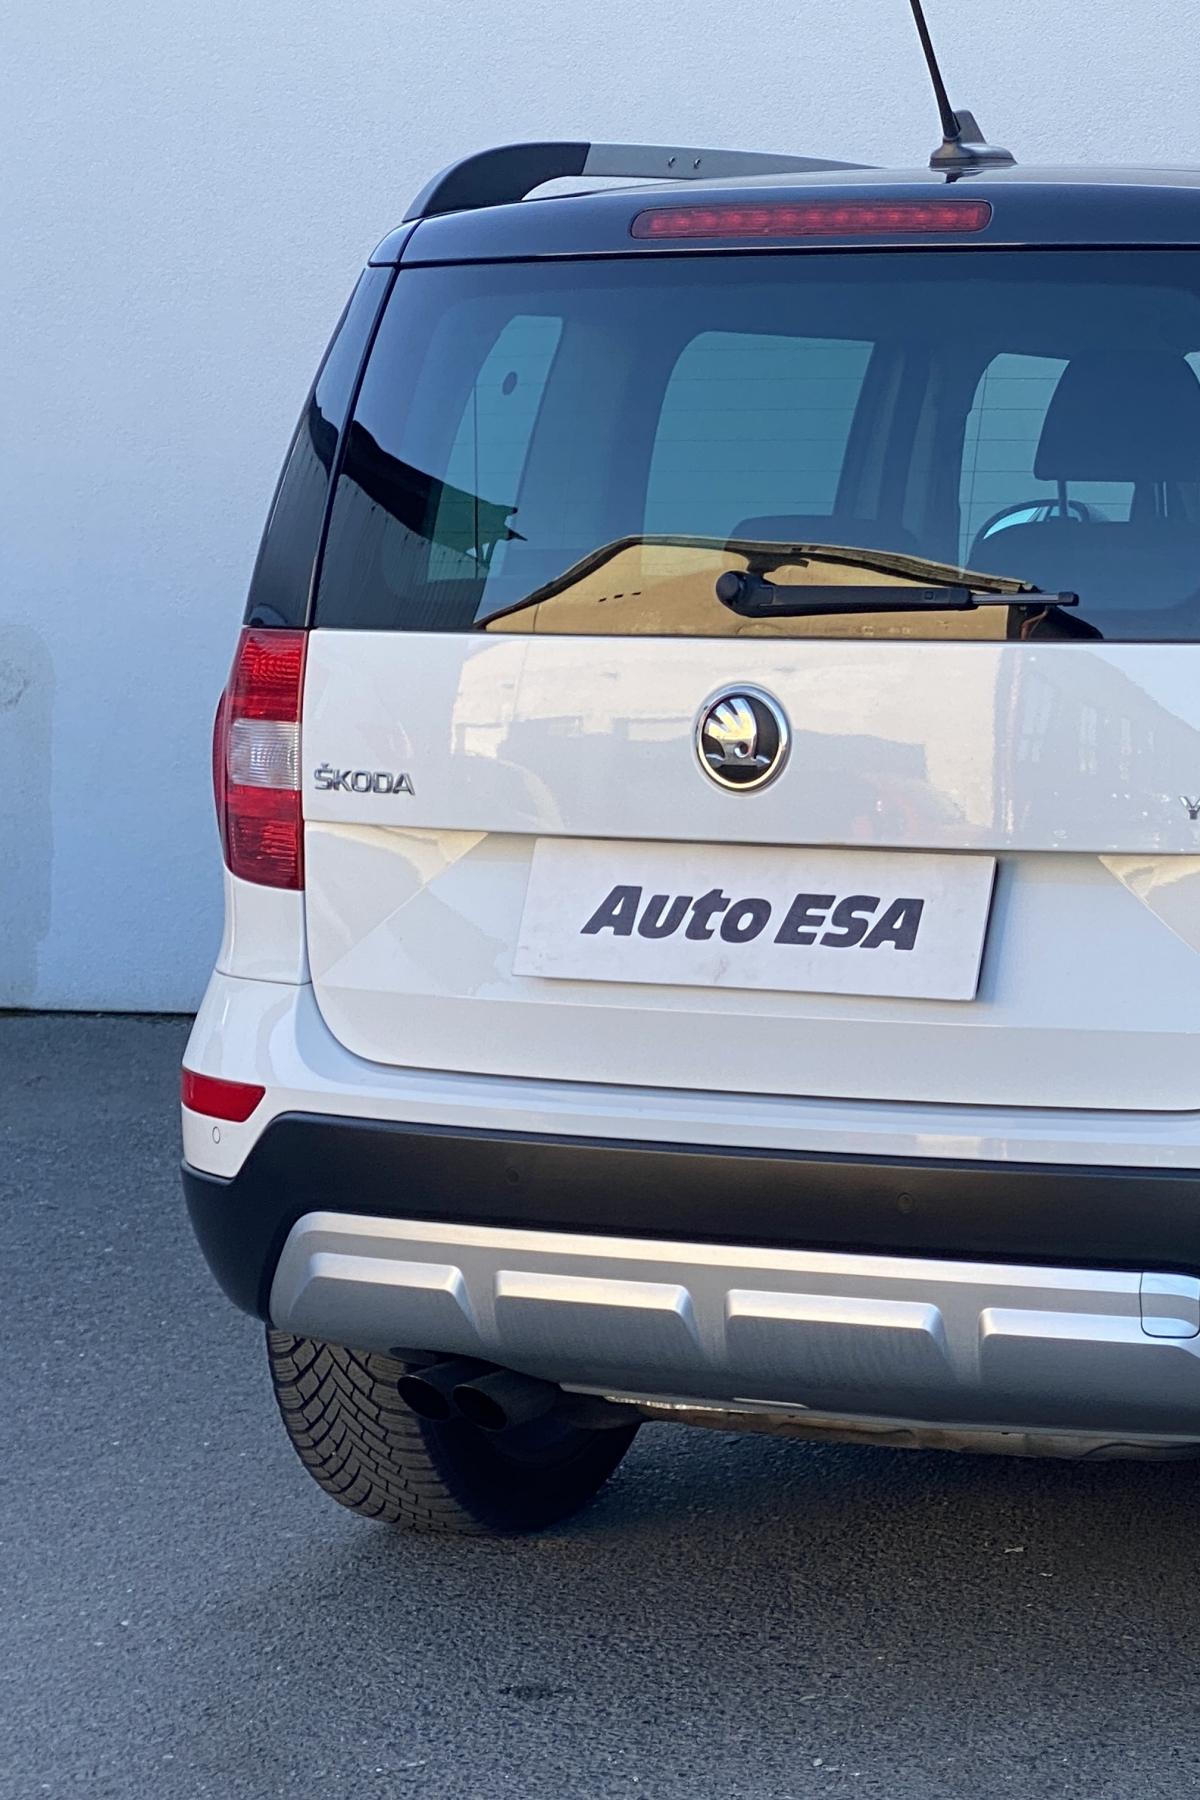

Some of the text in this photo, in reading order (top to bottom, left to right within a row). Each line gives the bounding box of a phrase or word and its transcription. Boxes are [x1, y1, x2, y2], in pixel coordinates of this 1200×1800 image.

[314, 763, 415, 796] ŠKODA
[580, 885, 925, 951] Auto ESA
